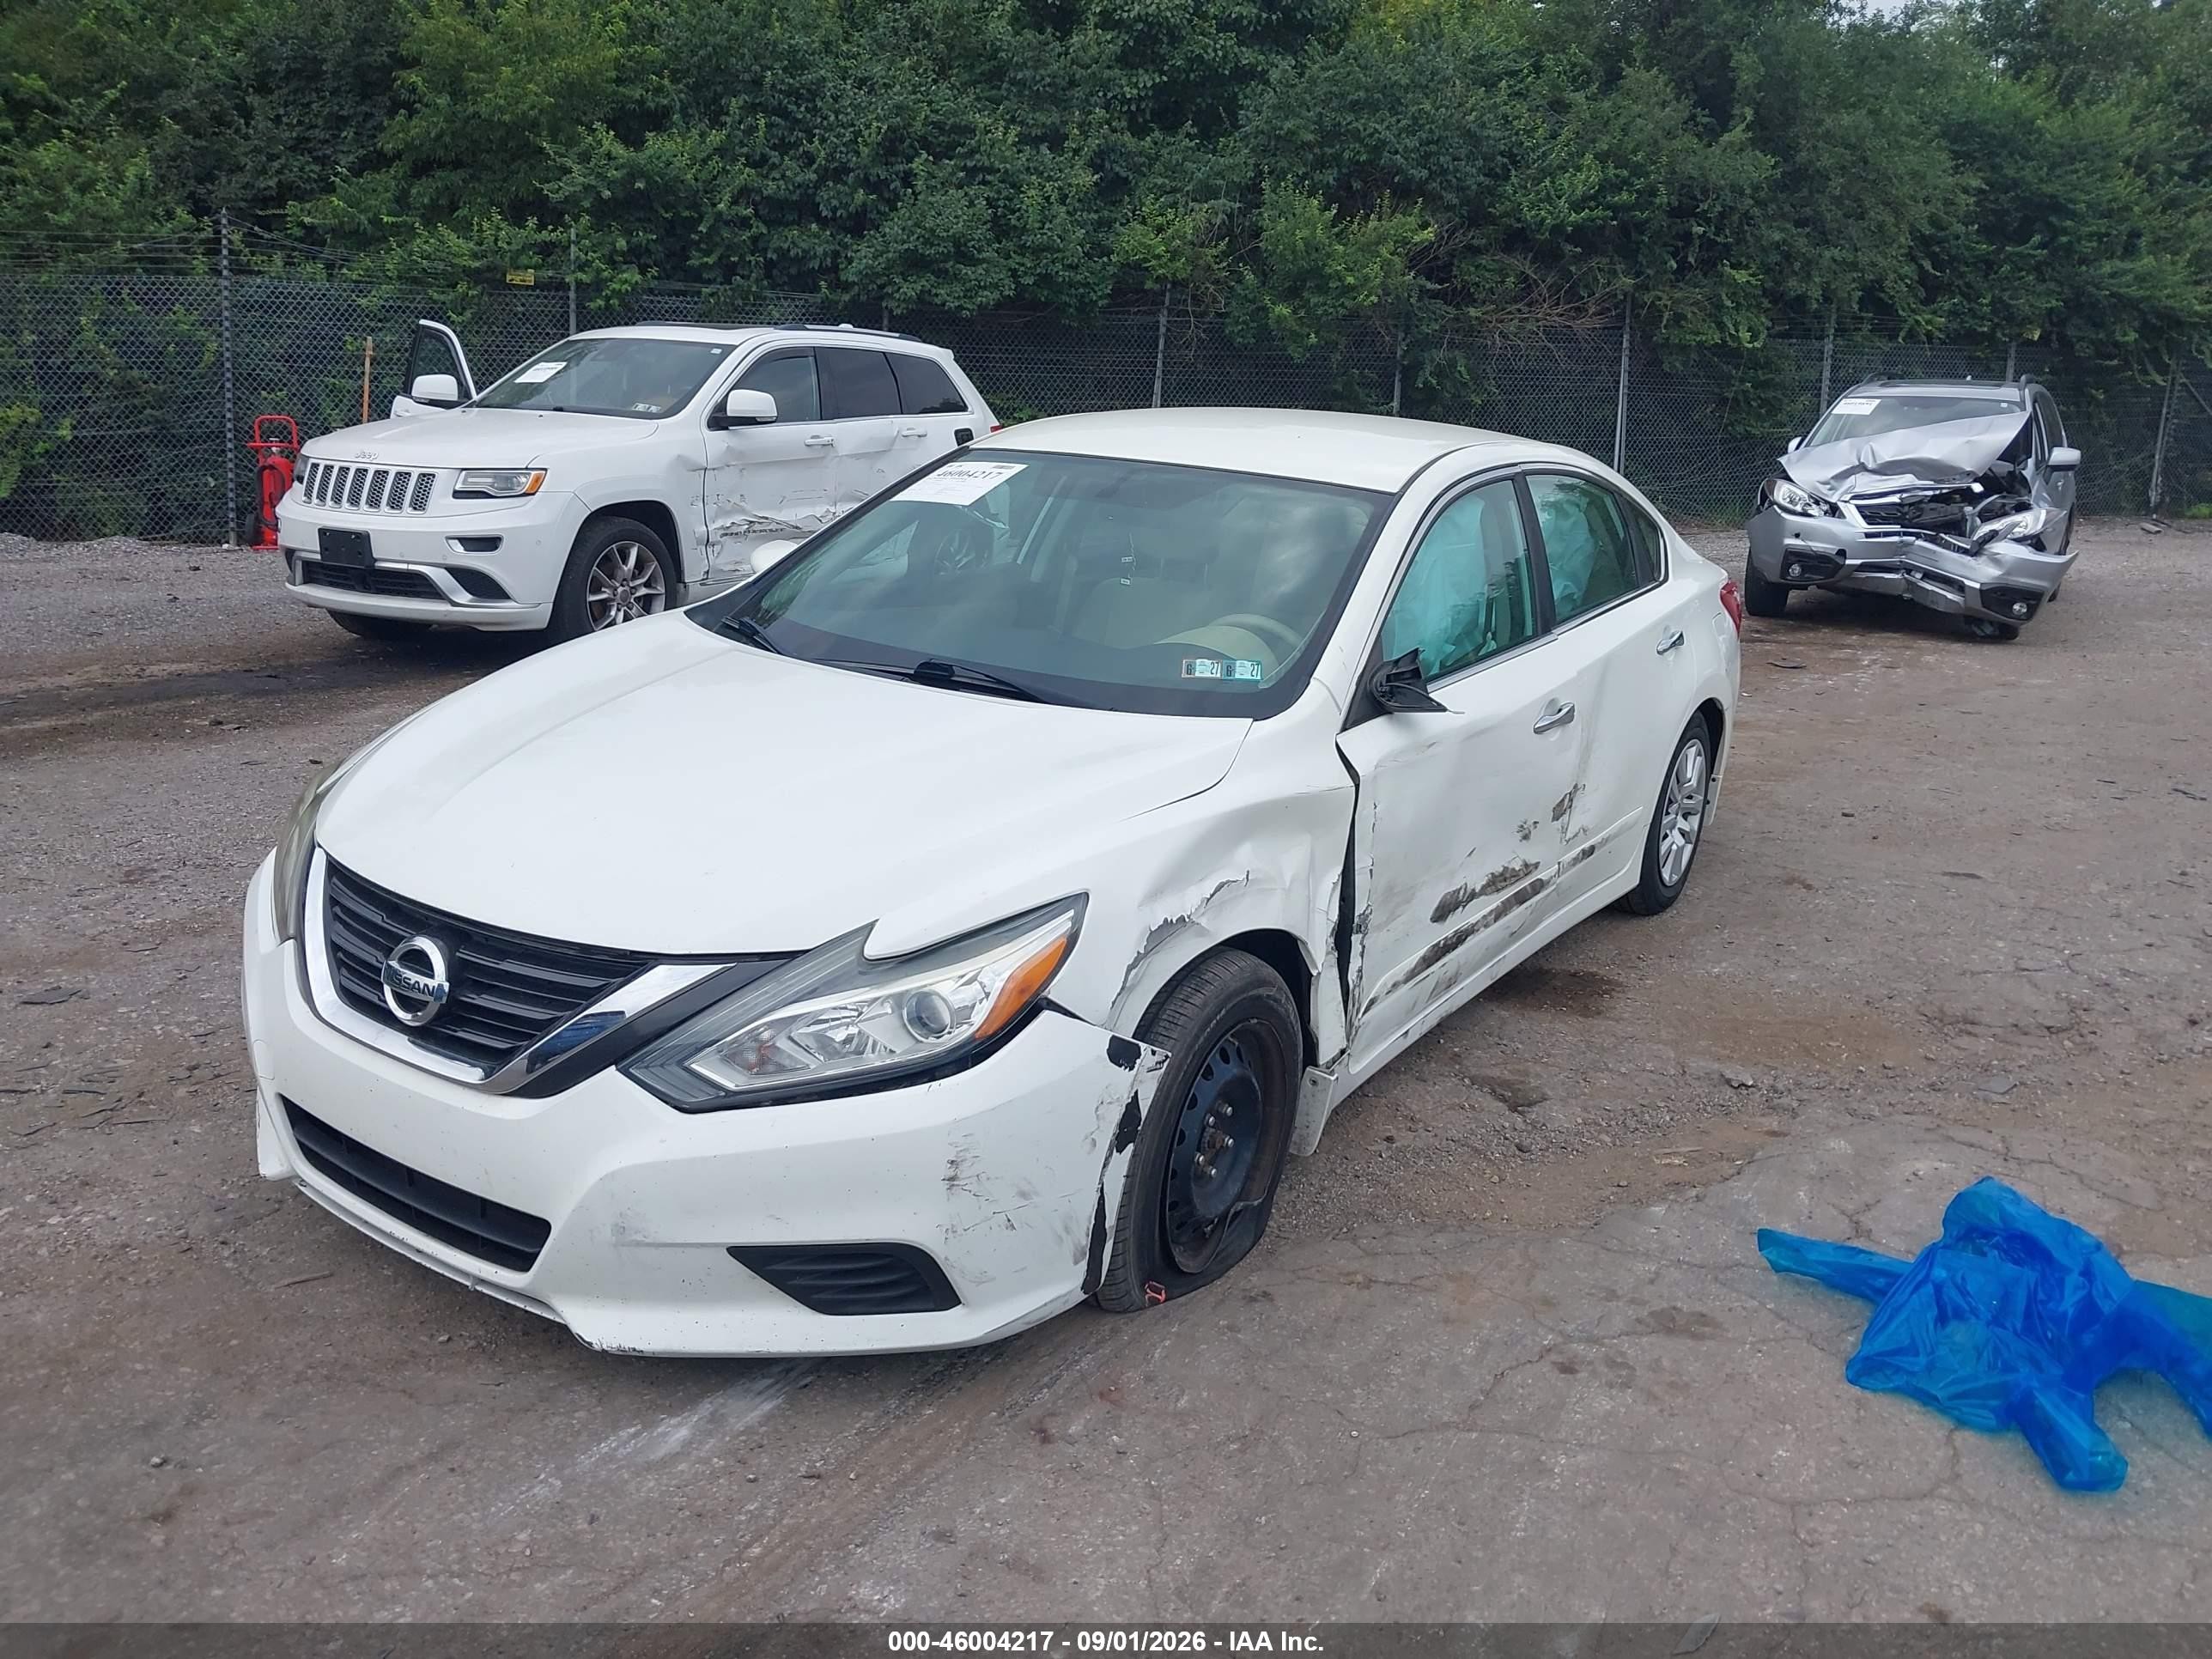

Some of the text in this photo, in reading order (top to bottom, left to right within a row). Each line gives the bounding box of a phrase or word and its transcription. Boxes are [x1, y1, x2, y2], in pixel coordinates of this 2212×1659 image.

[936, 470, 1003, 479] 46004217
[1210, 661, 1220, 676] 27
[1250, 663, 1260, 678] 27
[392, 973, 435, 997] SSAN
